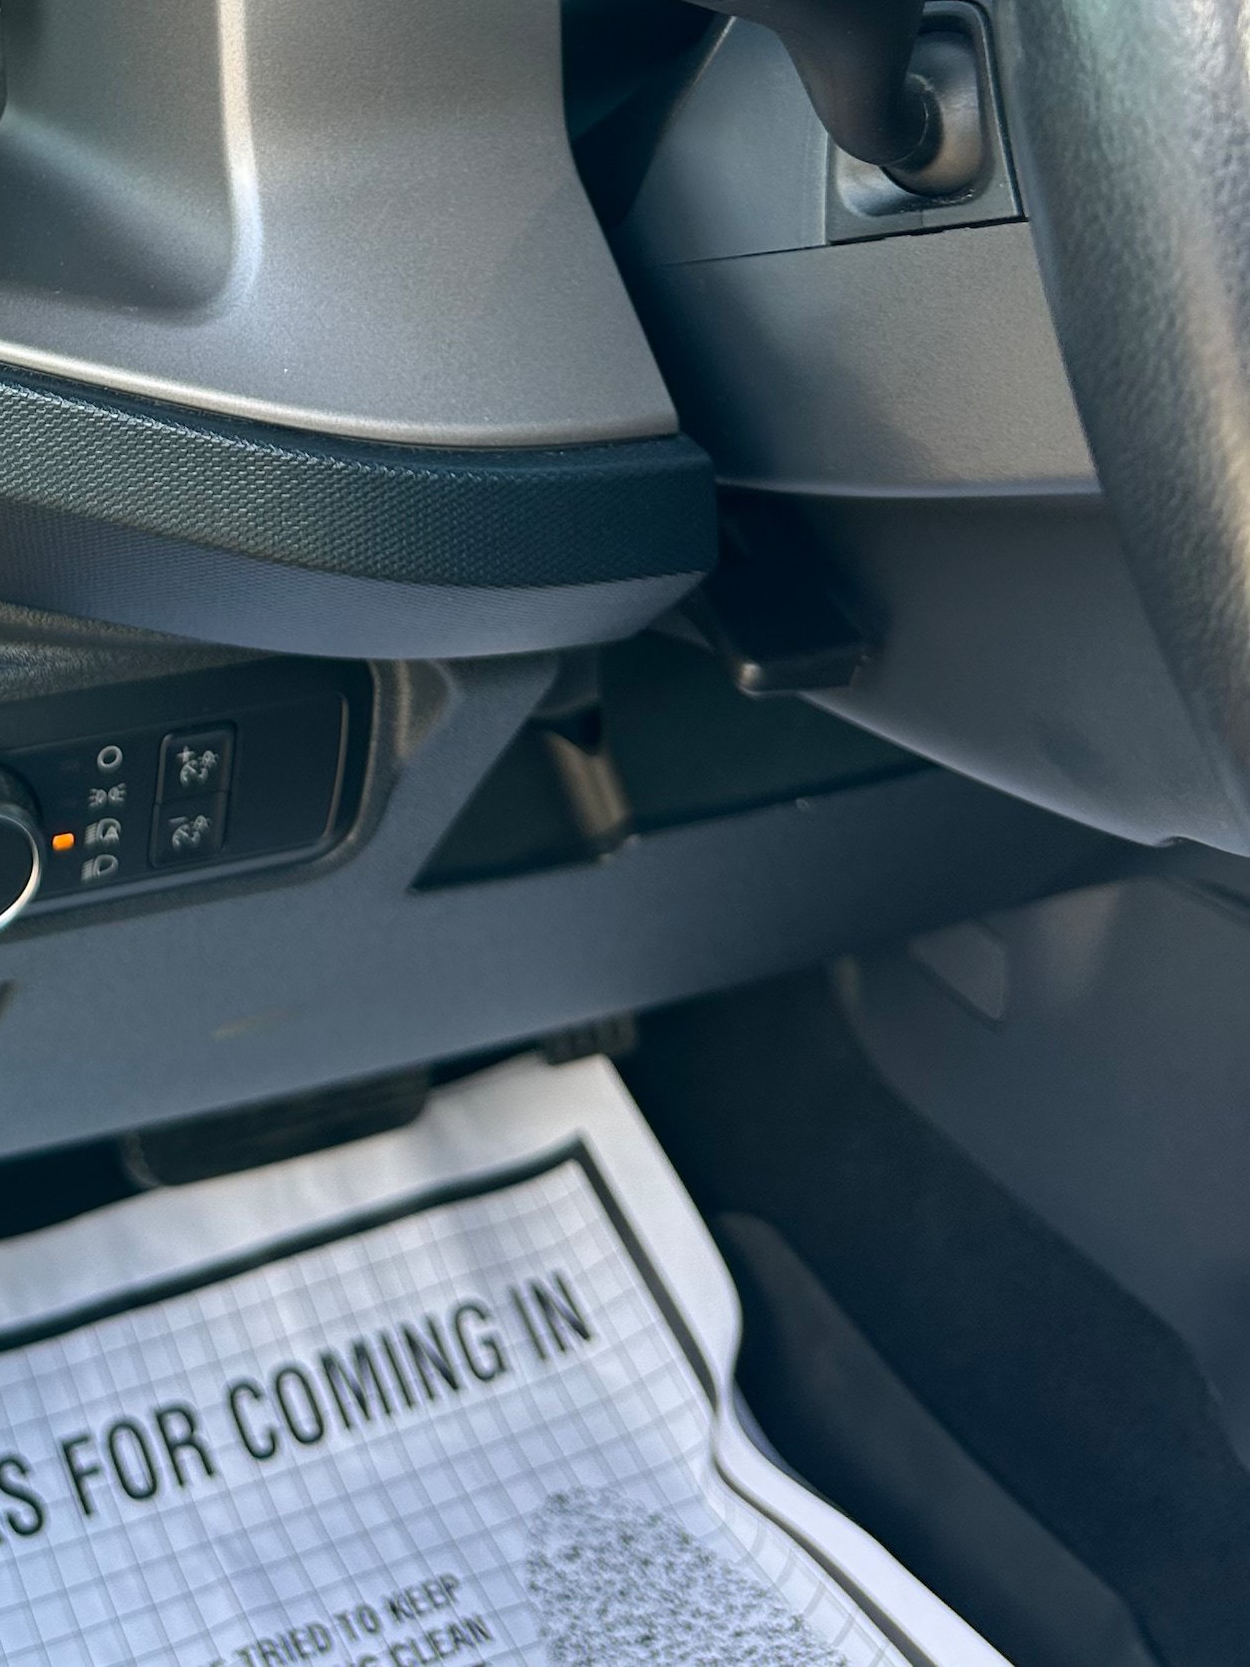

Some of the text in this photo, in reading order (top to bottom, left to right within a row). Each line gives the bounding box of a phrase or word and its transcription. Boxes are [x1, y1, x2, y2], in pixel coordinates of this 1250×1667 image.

[58, 1401, 216, 1518] FOR
[227, 1302, 504, 1462] COMING
[506, 1267, 595, 1369] IN
[234, 1571, 463, 1667] TRIED TO KEEP
[386, 1613, 498, 1667] CLEAN
